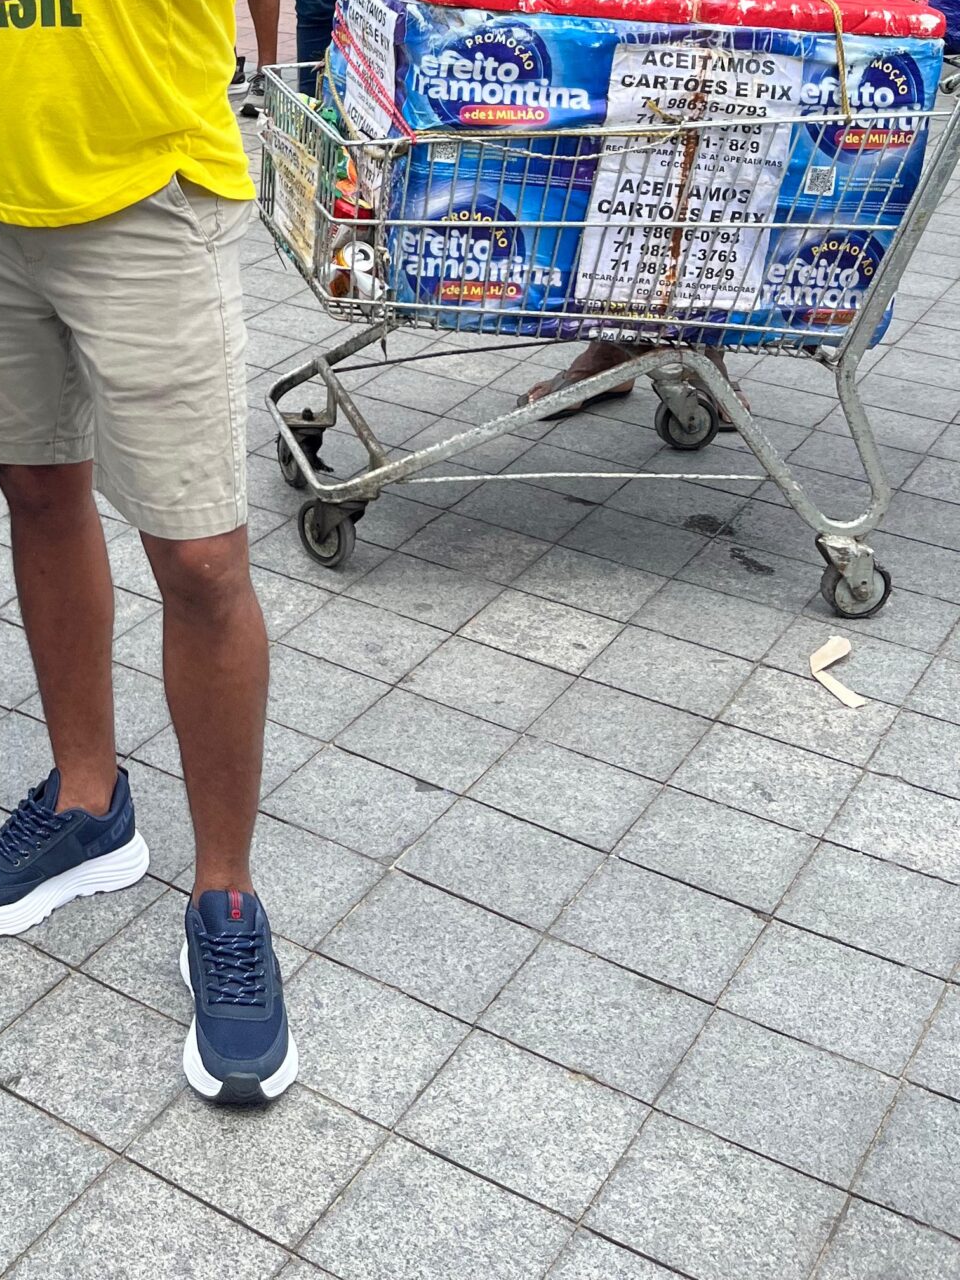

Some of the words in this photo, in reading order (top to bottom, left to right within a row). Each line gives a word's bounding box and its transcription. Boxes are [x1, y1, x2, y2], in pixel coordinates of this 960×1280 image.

[465, 33, 535, 71] PROMOÇÃO
[642, 50, 776, 76] ACEITAMOS
[421, 51, 520, 83] efeito
[620, 73, 728, 96] CARTÕES
[735, 82, 748, 98] E
[756, 83, 792, 101] PIX
[495, 107, 545, 121] MILHÃO
[441, 209, 509, 249] PROMOÃO
[643, 226, 740, 244] 9866-0793
[613, 240, 632, 255] 71
[610, 258, 629, 272] 71
[655, 279, 683, 288] ODAS
